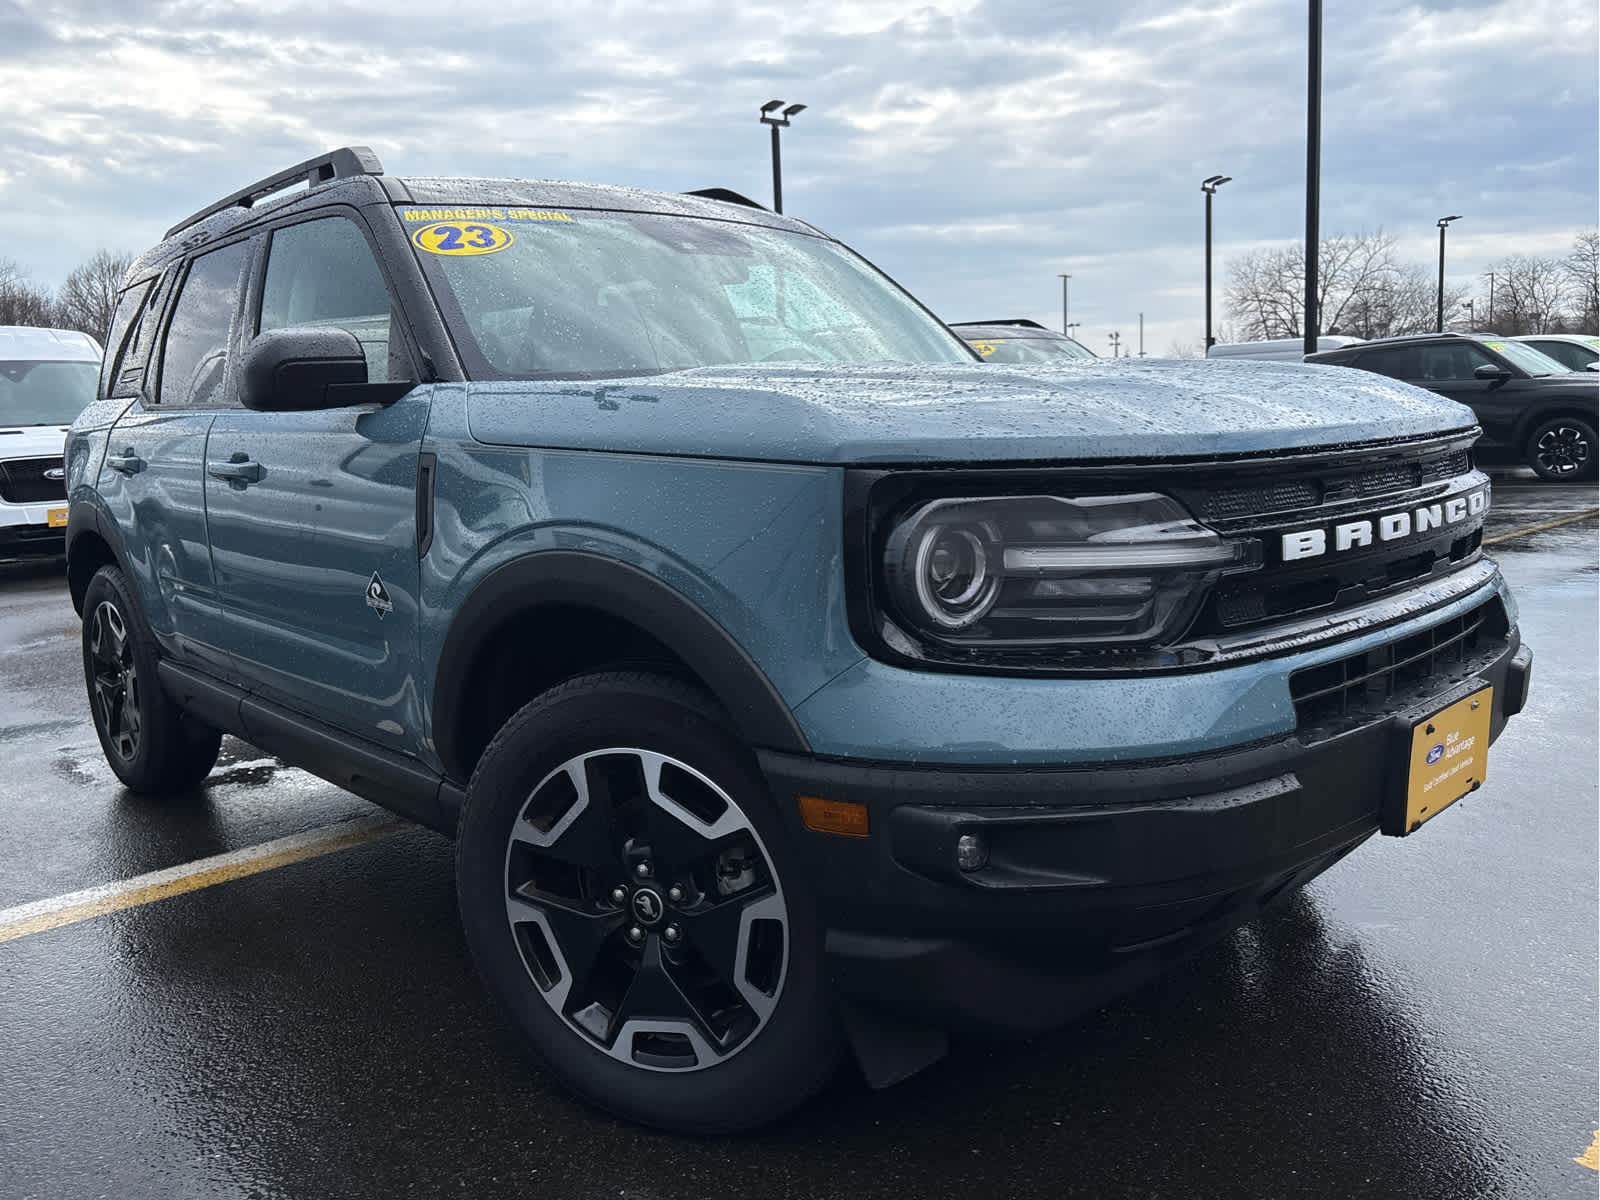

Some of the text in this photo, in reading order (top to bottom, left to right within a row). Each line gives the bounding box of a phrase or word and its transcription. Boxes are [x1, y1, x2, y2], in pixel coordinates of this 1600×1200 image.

[404, 208, 576, 223] MANAGER'S SPECIAL
[433, 226, 496, 250] 23
[1282, 492, 1485, 561] BRONCO
